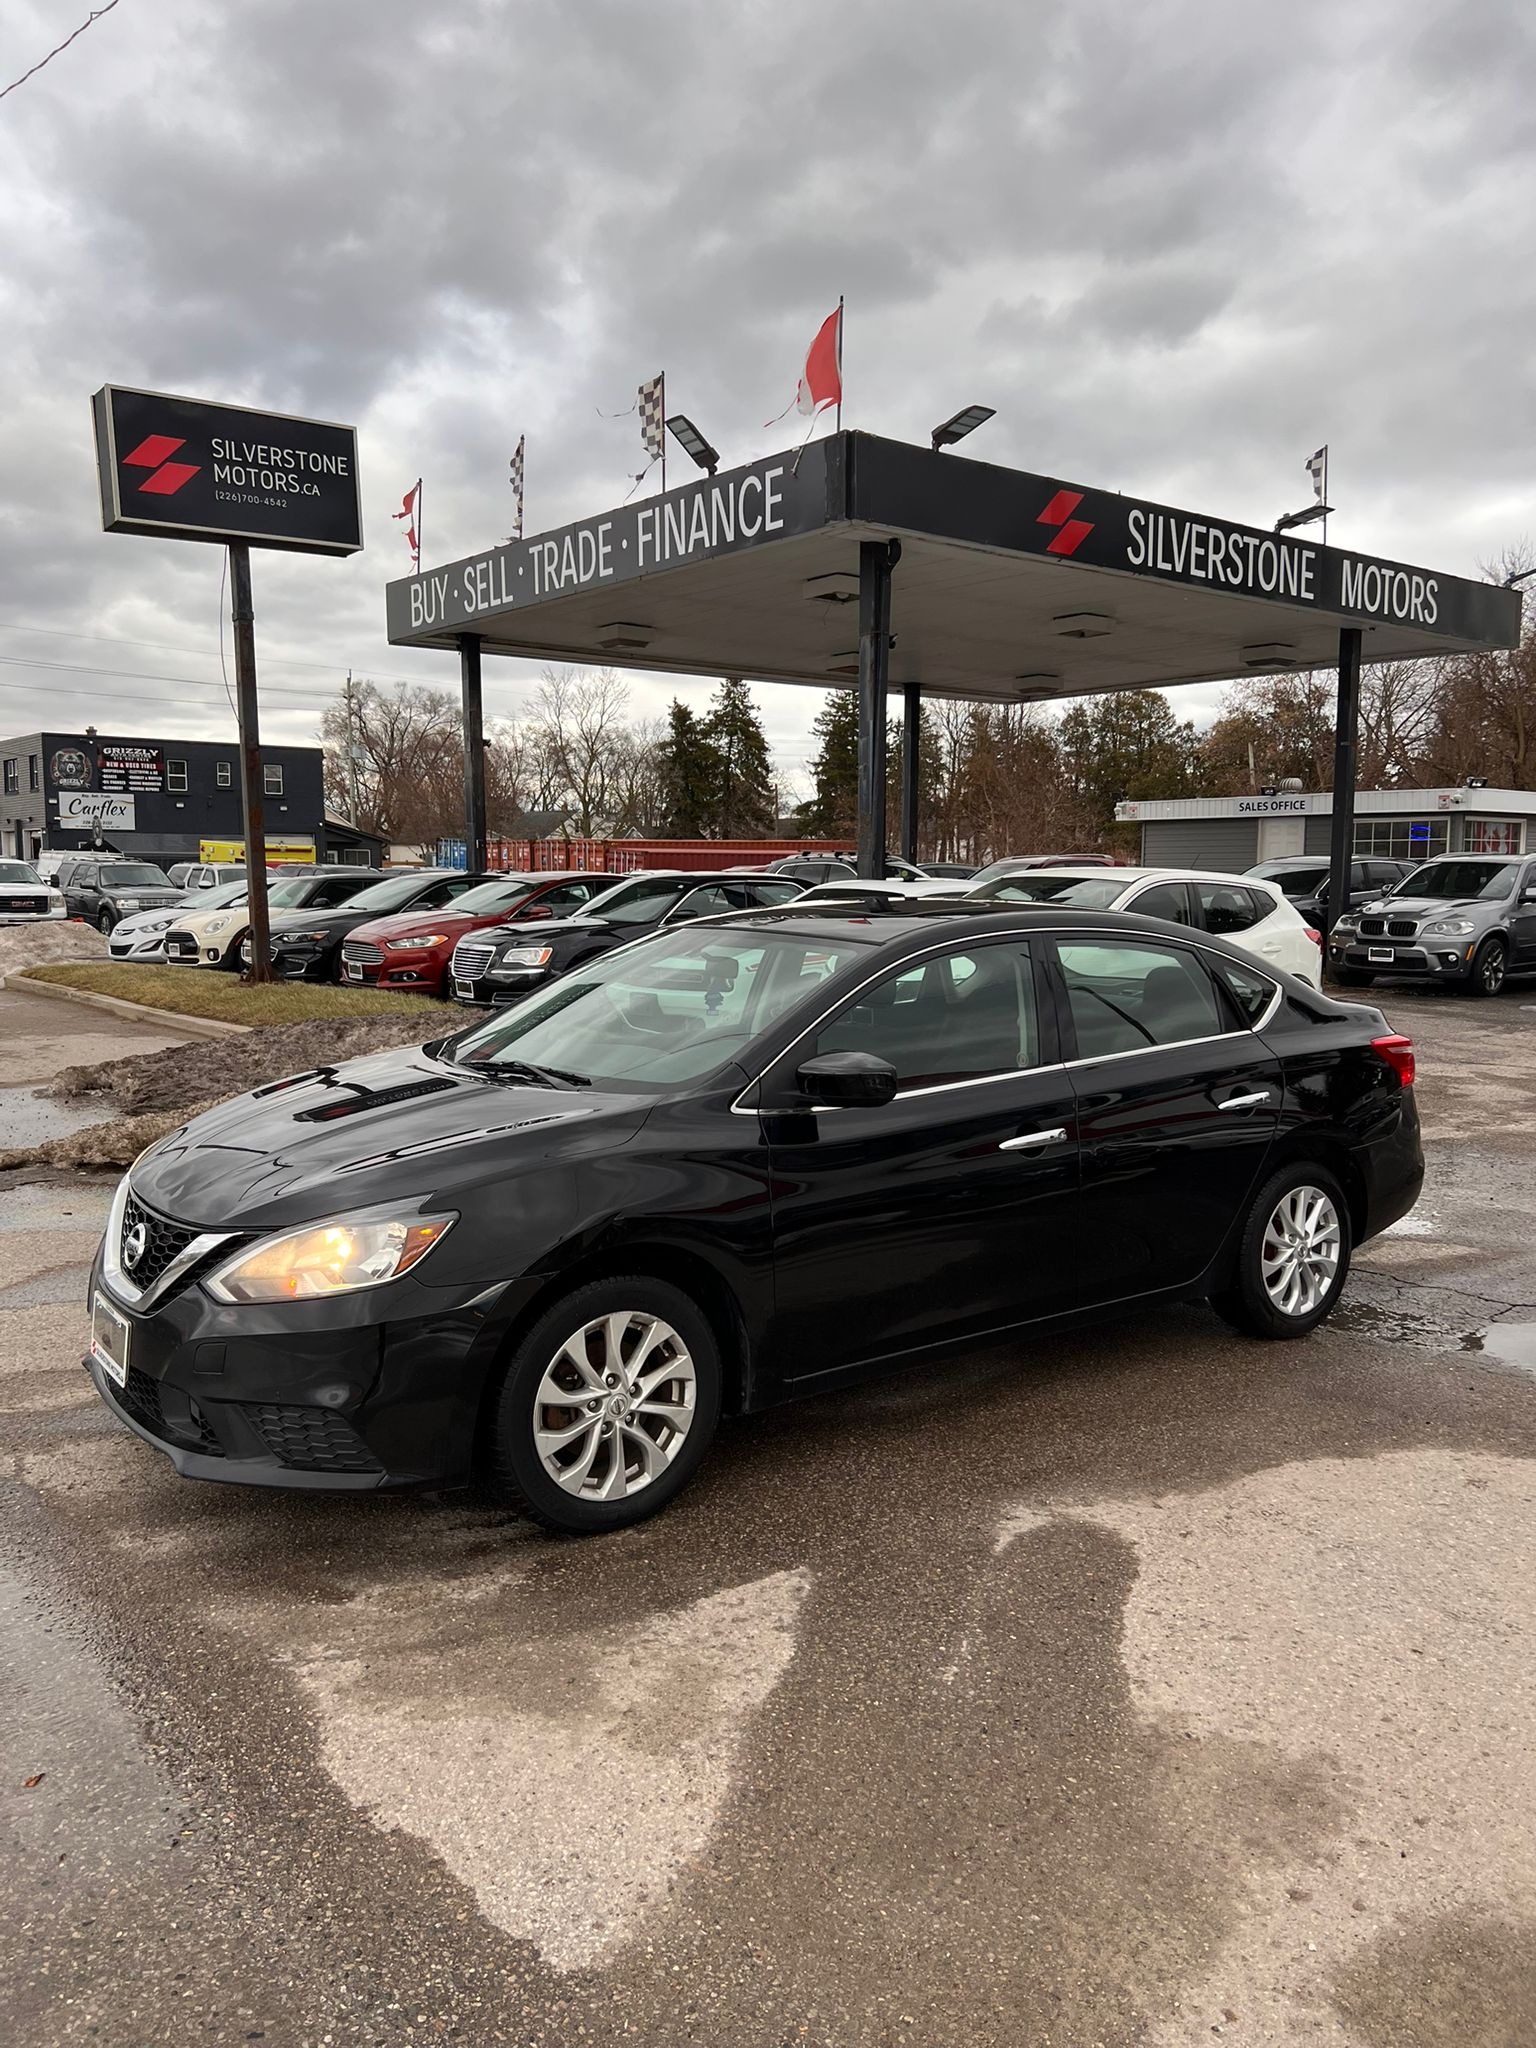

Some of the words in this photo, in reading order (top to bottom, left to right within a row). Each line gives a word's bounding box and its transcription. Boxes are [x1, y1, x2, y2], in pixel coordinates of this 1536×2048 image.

[211, 438, 349, 476] SILVERSTONE
[213, 463, 321, 496] MOTORS.CA
[215, 490, 287, 508] (226)700-4542
[410, 574, 449, 628] BUY
[463, 555, 514, 613] SELL
[528, 522, 613, 595] TRADE
[636, 466, 784, 567] FINANCE
[1126, 509, 1316, 601] SILVERSTONE
[1340, 559, 1438, 625] MOTORS
[102, 747, 159, 757] GRIZZLY
[68, 798, 127, 819] Carflex
[1238, 801, 1269, 812] SALES
[1270, 800, 1306, 811] OFFICE
